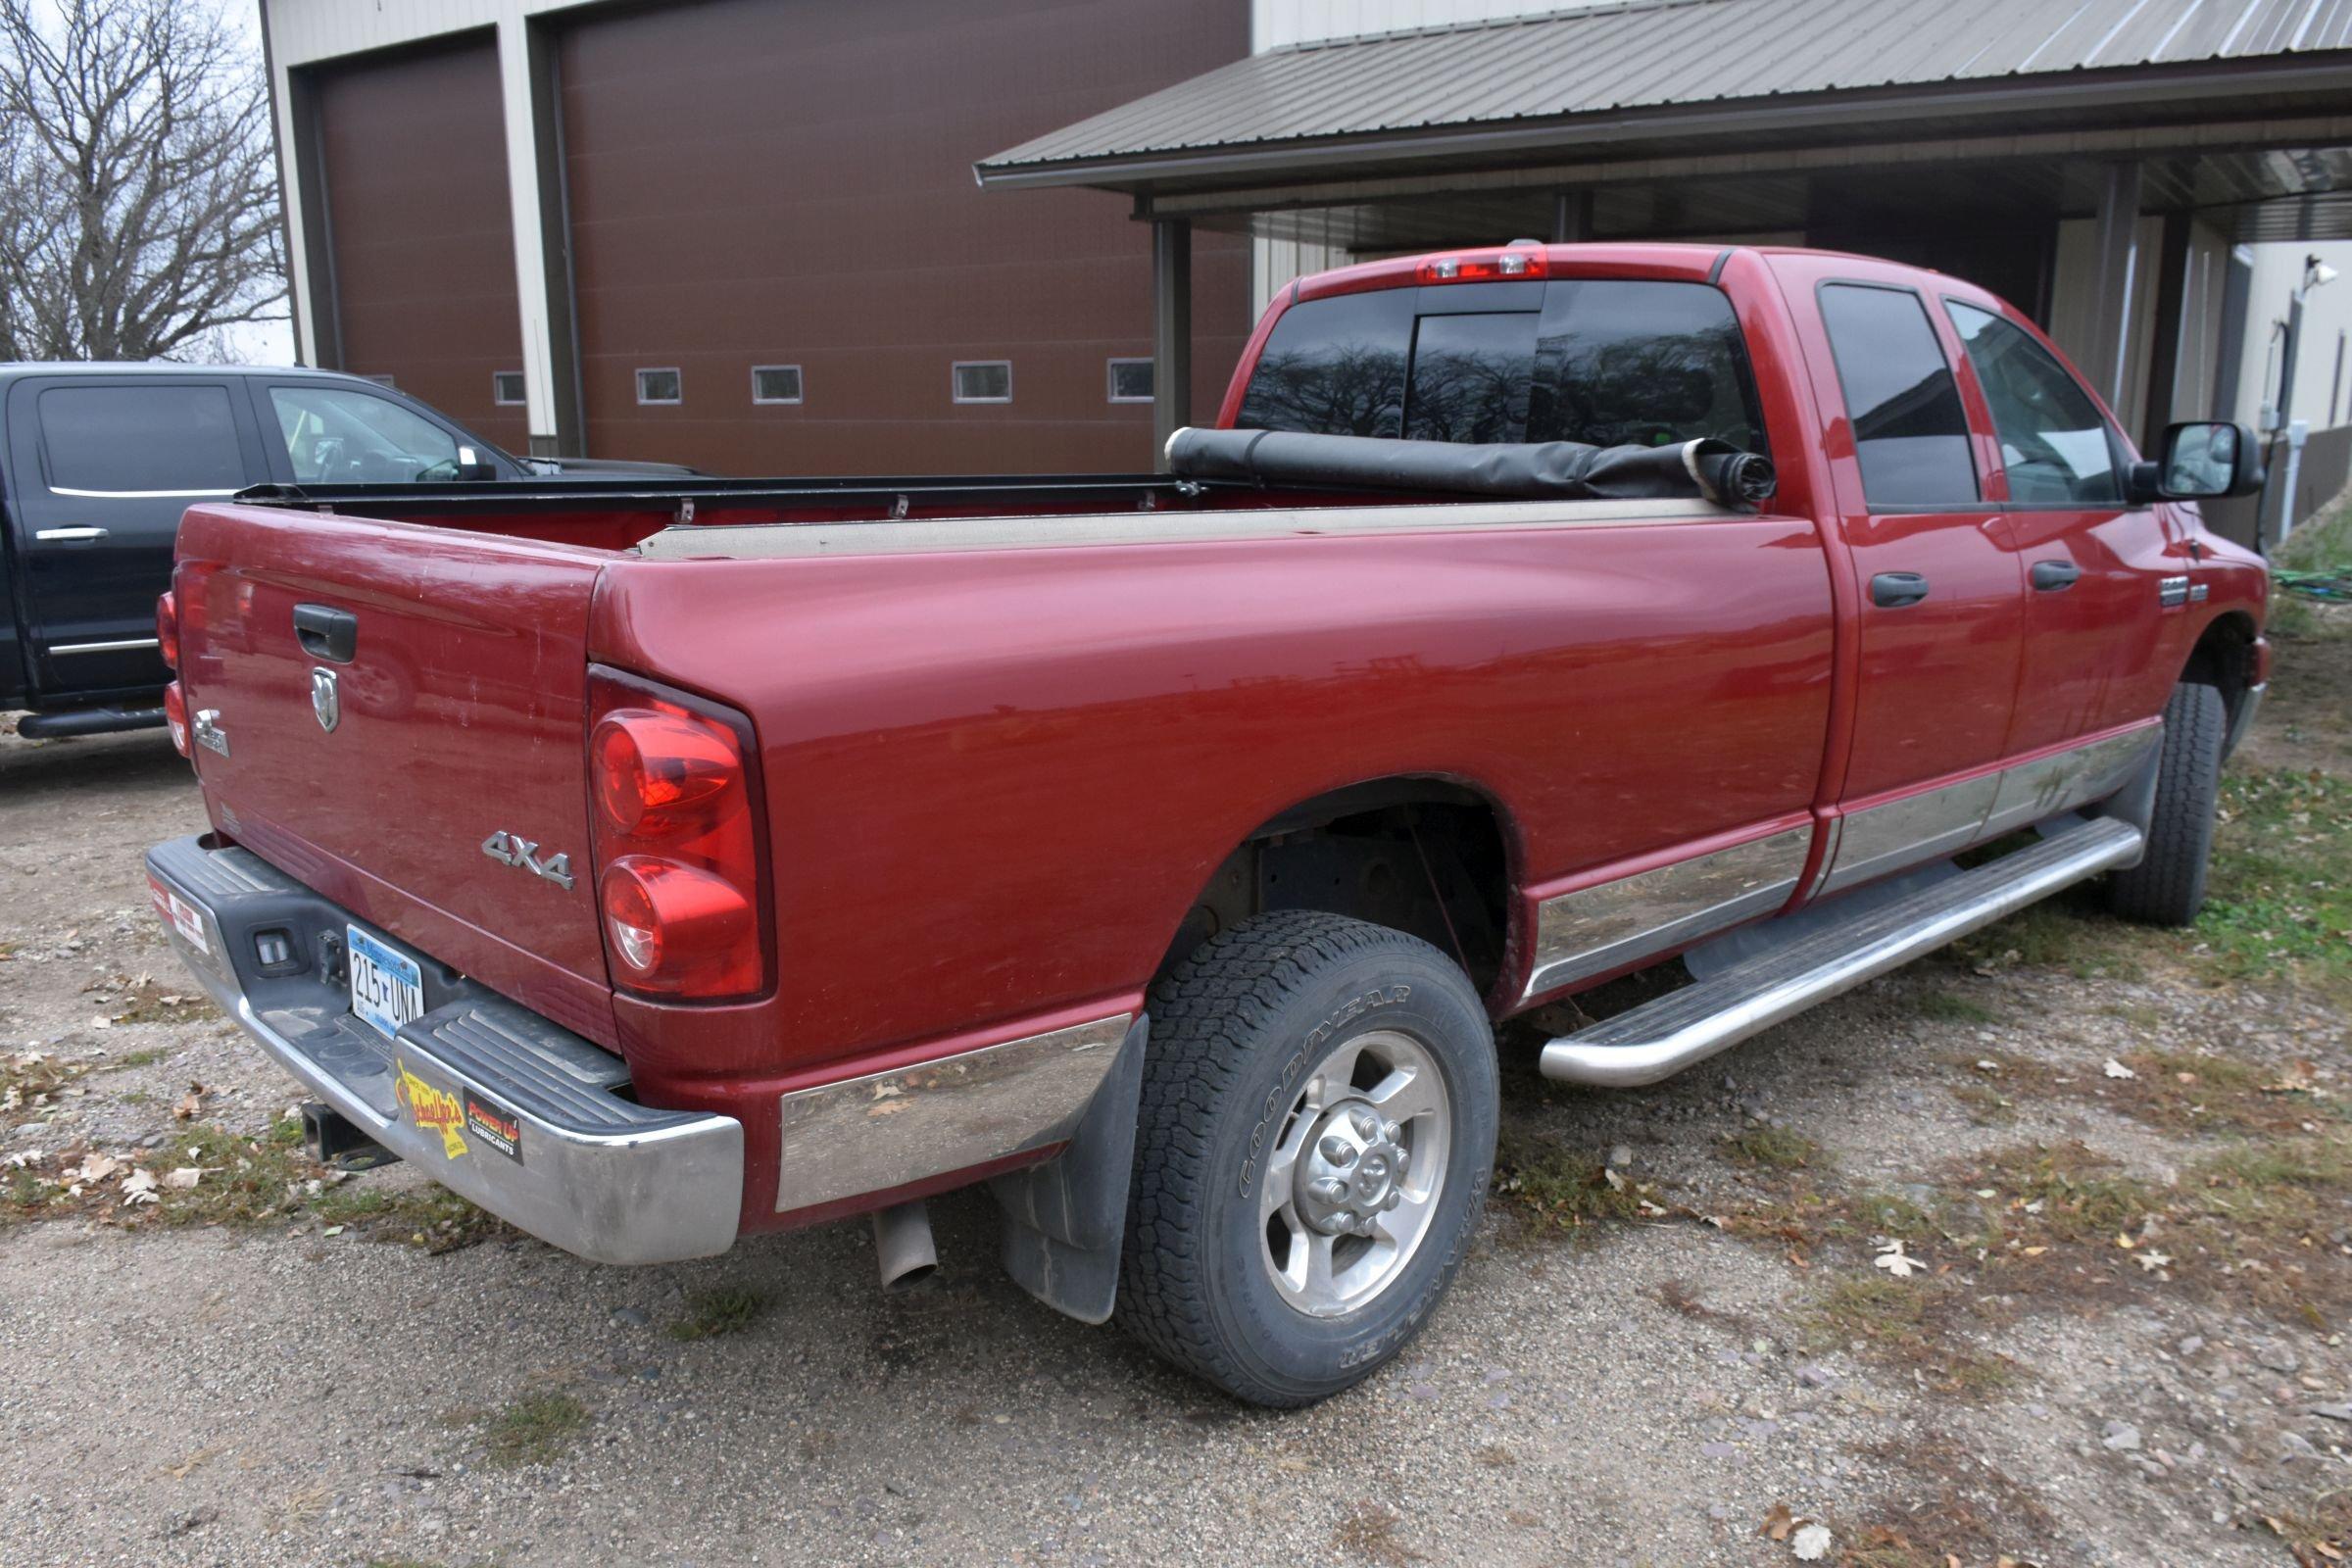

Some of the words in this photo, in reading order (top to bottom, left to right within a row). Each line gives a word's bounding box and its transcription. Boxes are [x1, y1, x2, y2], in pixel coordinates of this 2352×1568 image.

[354, 952, 380, 1008] 215
[1239, 985, 1412, 1200] GOODYEAR
[467, 1101, 503, 1132] POWER
[503, 1121, 518, 1143] UP
[470, 1123, 514, 1156] LUBRICANTS
